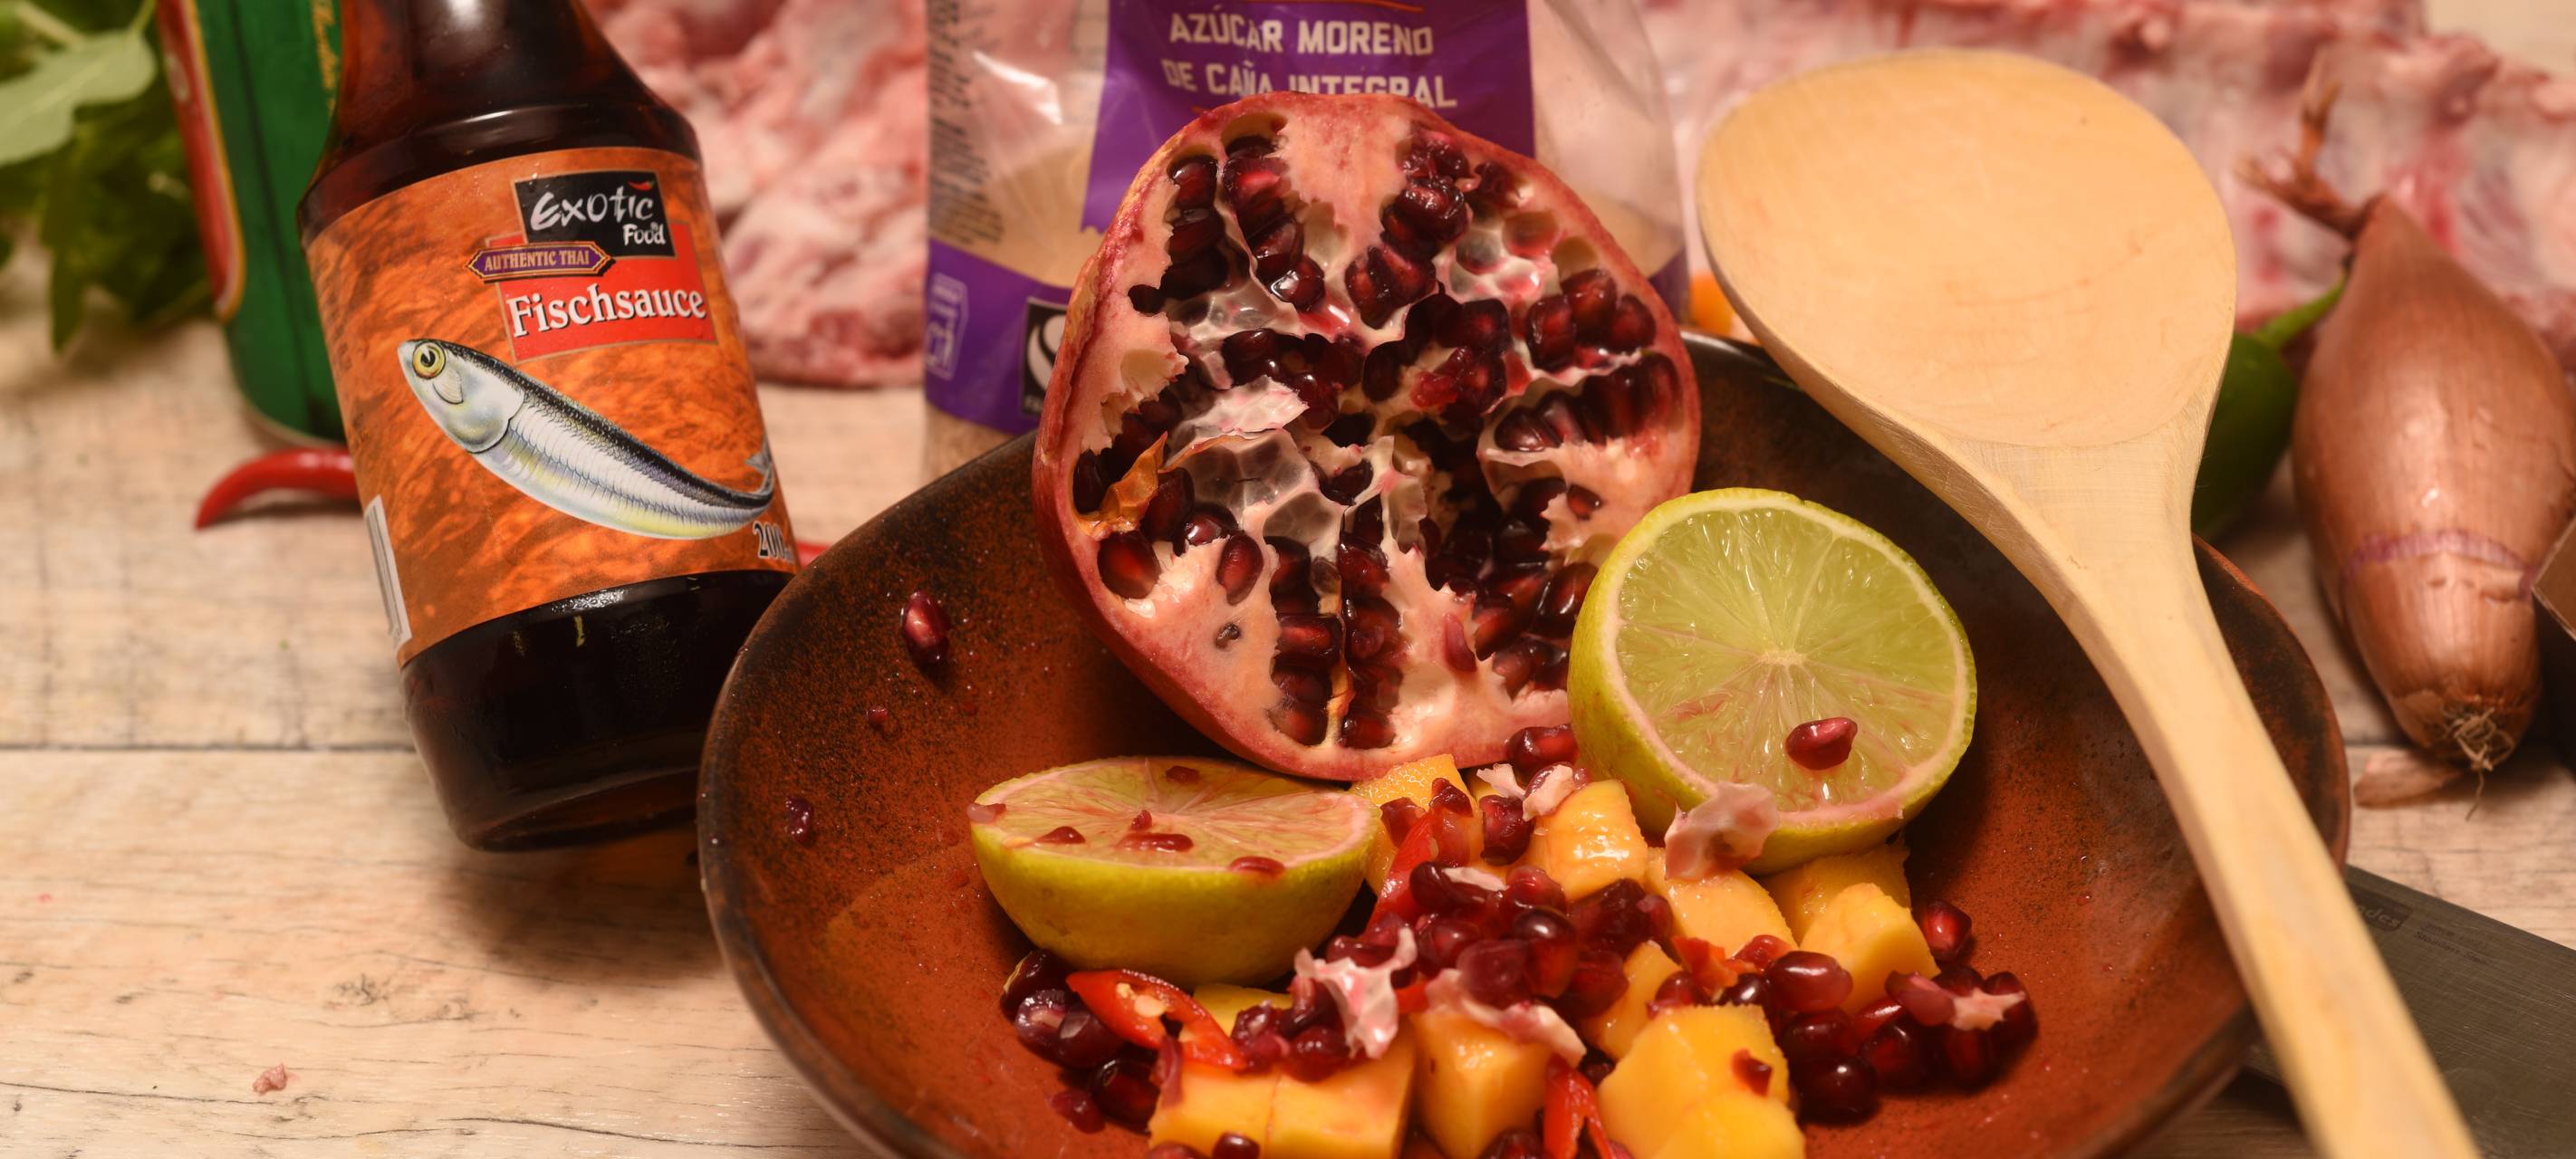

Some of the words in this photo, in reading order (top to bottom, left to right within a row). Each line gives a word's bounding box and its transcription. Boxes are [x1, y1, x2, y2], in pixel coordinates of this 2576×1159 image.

[1169, 5, 1283, 53] AZÚCAR
[1298, 20, 1434, 56] MORENO
[1161, 59, 1197, 91] DE
[1206, 61, 1274, 97] CAÑA
[530, 186, 654, 231] Exotic
[622, 223, 666, 246] Food
[485, 251, 556, 272] AUTHENTIC
[559, 250, 590, 266] THAI
[506, 283, 706, 337] Fischsauce
